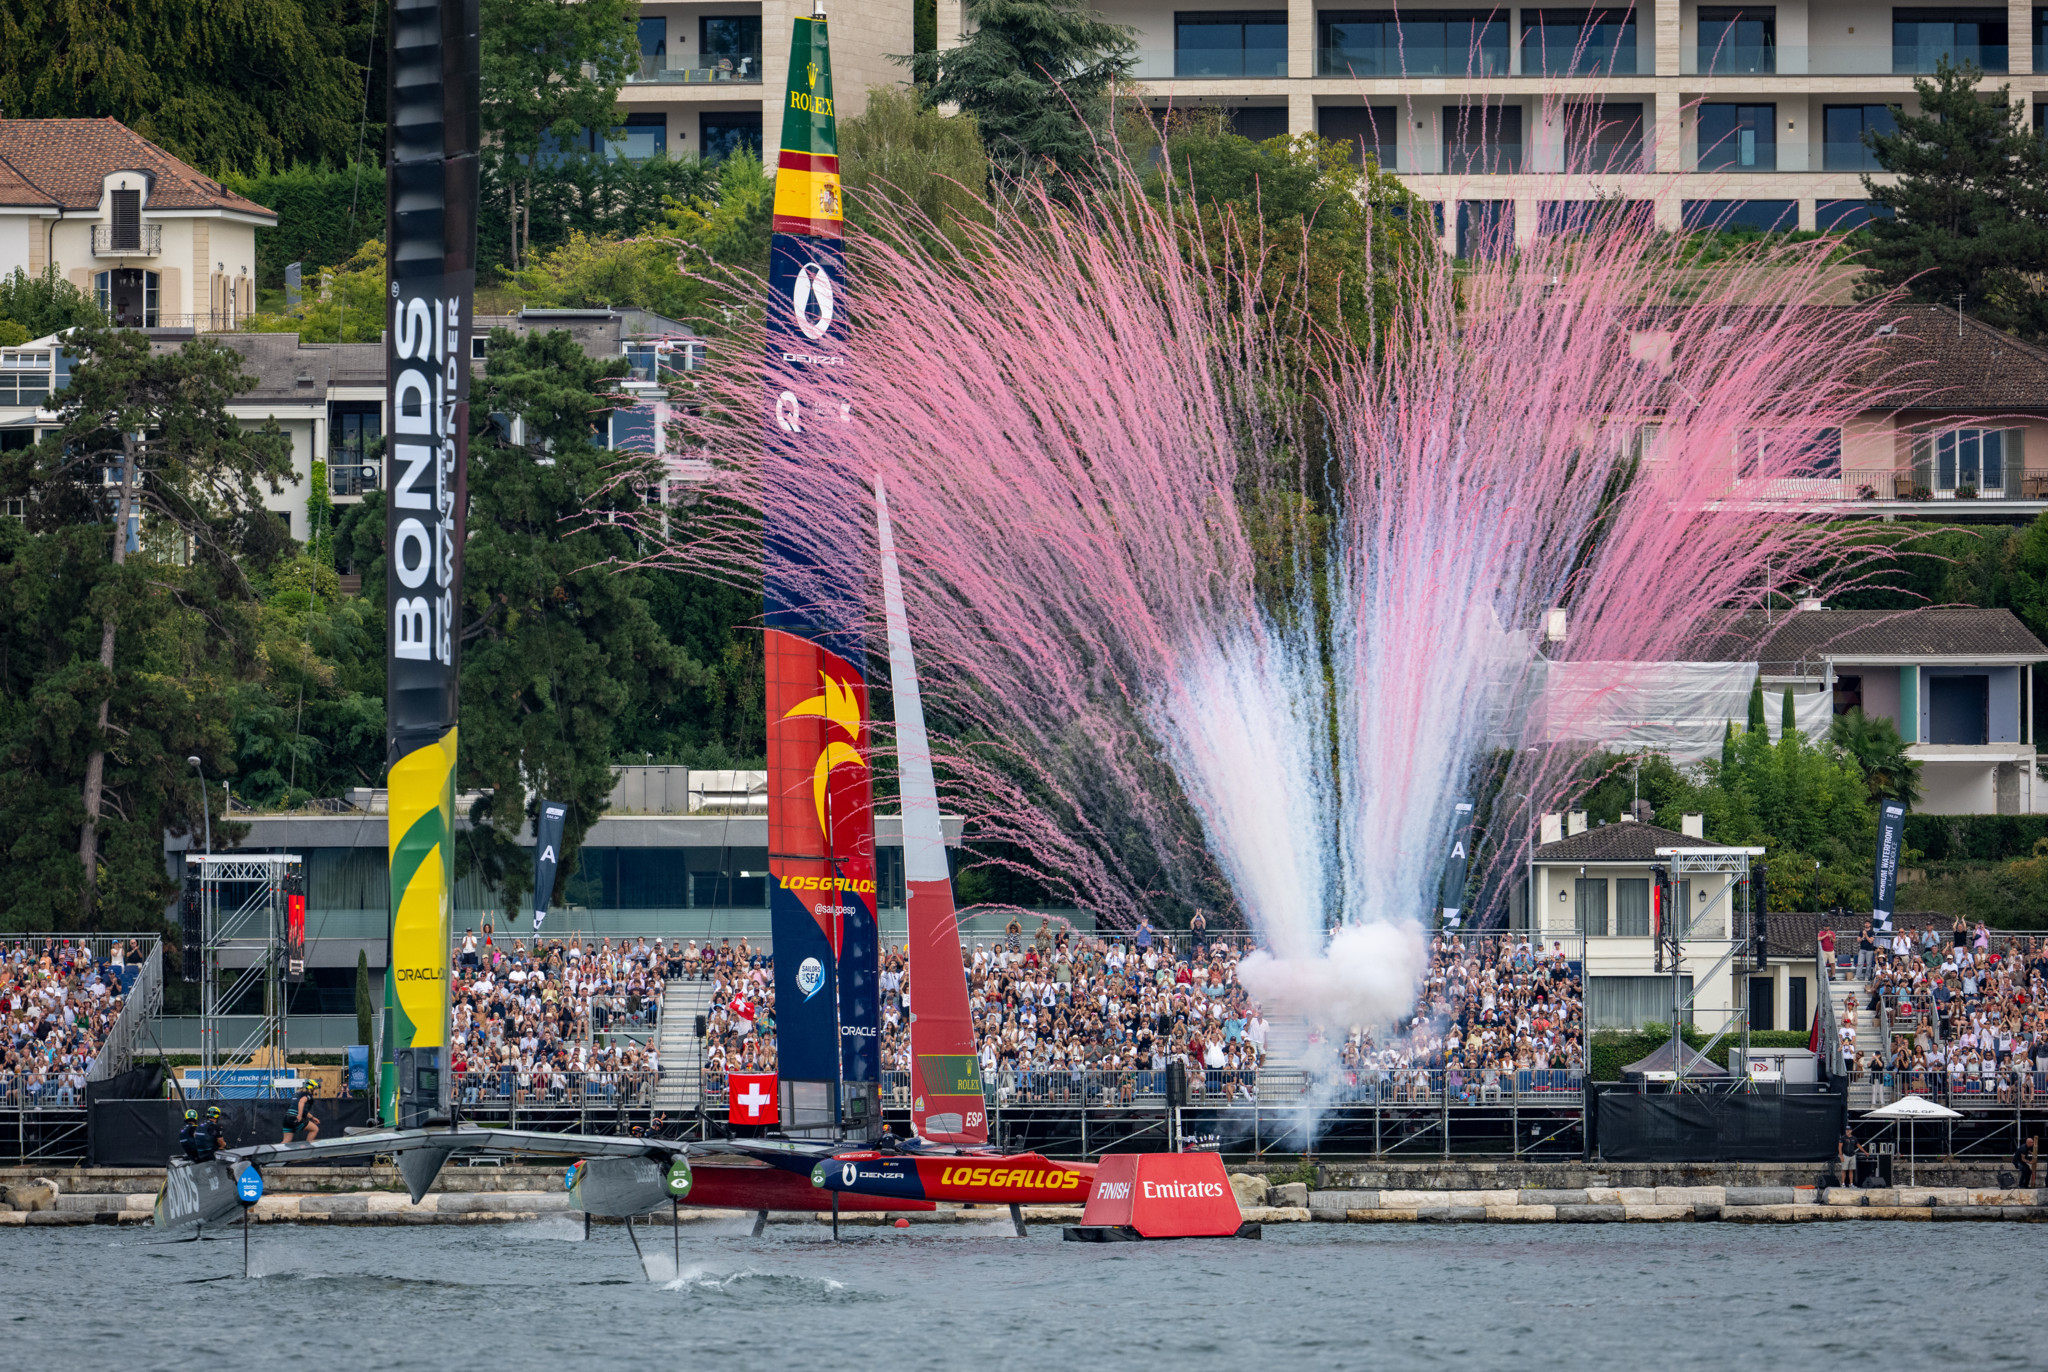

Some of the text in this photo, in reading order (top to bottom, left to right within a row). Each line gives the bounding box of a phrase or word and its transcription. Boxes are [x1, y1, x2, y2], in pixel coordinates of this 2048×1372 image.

[791, 90, 833, 116] ROLEX
[446, 295, 460, 474] UNDER
[395, 297, 432, 661] BONDS
[540, 845, 556, 863] A
[1450, 841, 1466, 859] A
[1879, 824, 1893, 901] PREMIUM WATERFRONT
[780, 875, 877, 893] LOSGALLOS
[801, 965, 821, 973] SAILORS
[805, 972, 819, 984] SEA
[841, 1026, 877, 1037] ORACLE
[238, 1074, 259, 1082] proche
[957, 1079, 980, 1090] ROLEX
[965, 1112, 983, 1127] ESP
[859, 1171, 905, 1179] DENZA
[941, 1166, 1081, 1189] LOSGALLOS
[1097, 1182, 1131, 1199] FINISH
[1142, 1180, 1224, 1199] Emirates
